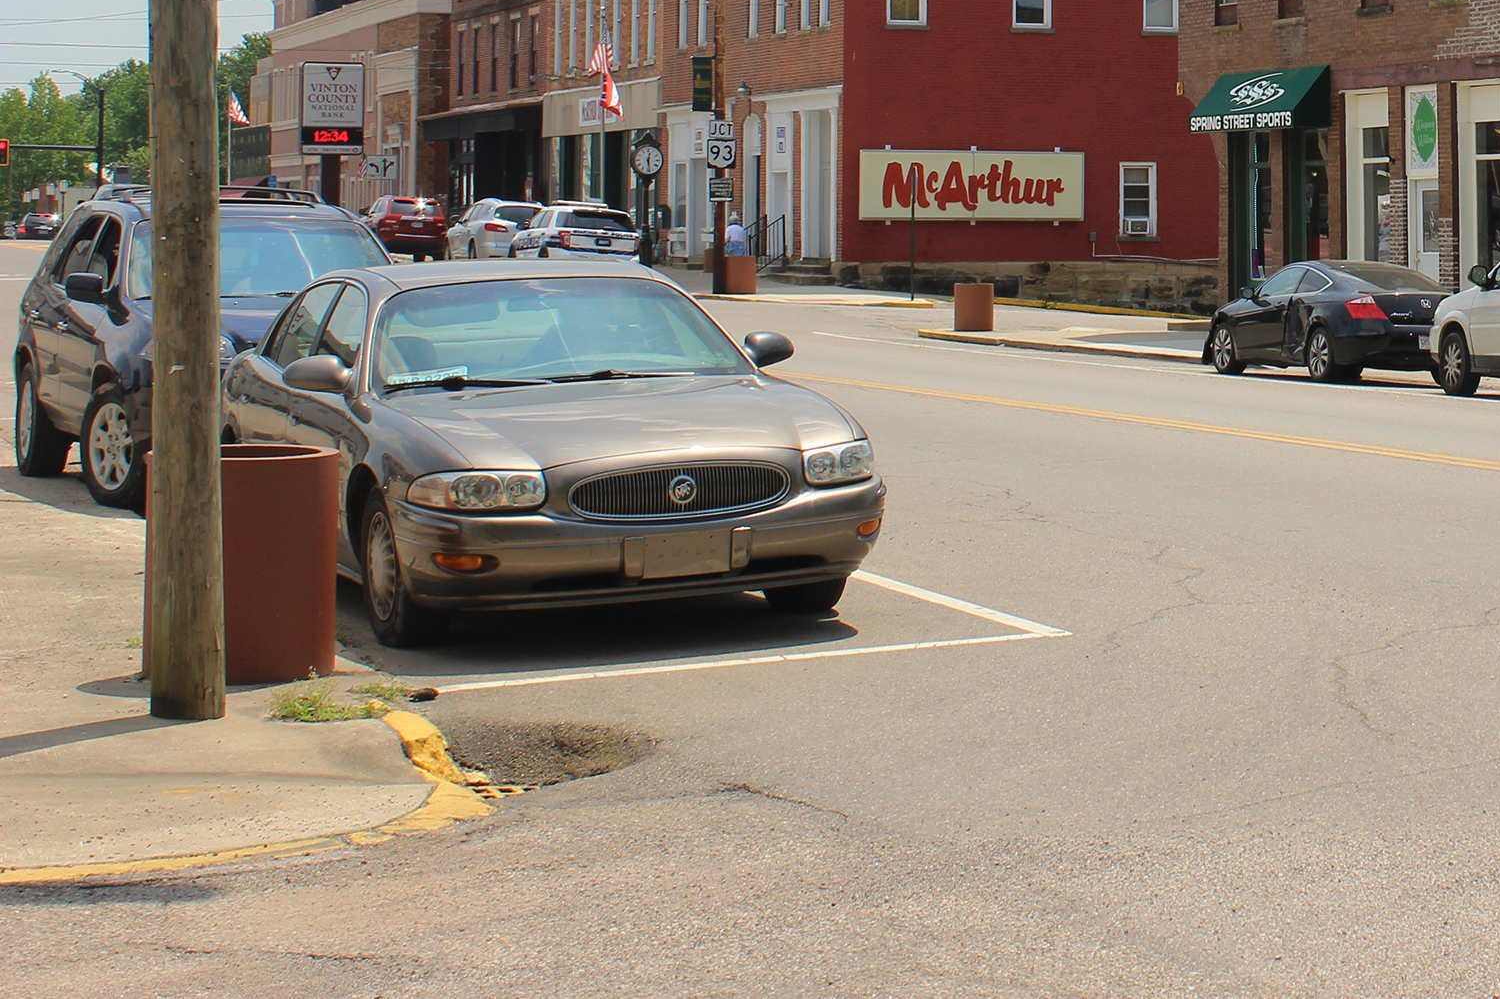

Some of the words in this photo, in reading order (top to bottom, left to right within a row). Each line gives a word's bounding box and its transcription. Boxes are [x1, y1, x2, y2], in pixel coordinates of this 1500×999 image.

[310, 83, 357, 93] VINTON
[308, 93, 358, 103] COUNTY
[1190, 115, 1222, 131] SPRING
[1222, 113, 1255, 130] STREET
[1256, 111, 1292, 128] SPORTS
[710, 123, 733, 136] JCT
[313, 130, 349, 143] 12:34
[710, 145, 733, 162] 93
[882, 159, 1065, 212] McArthur
